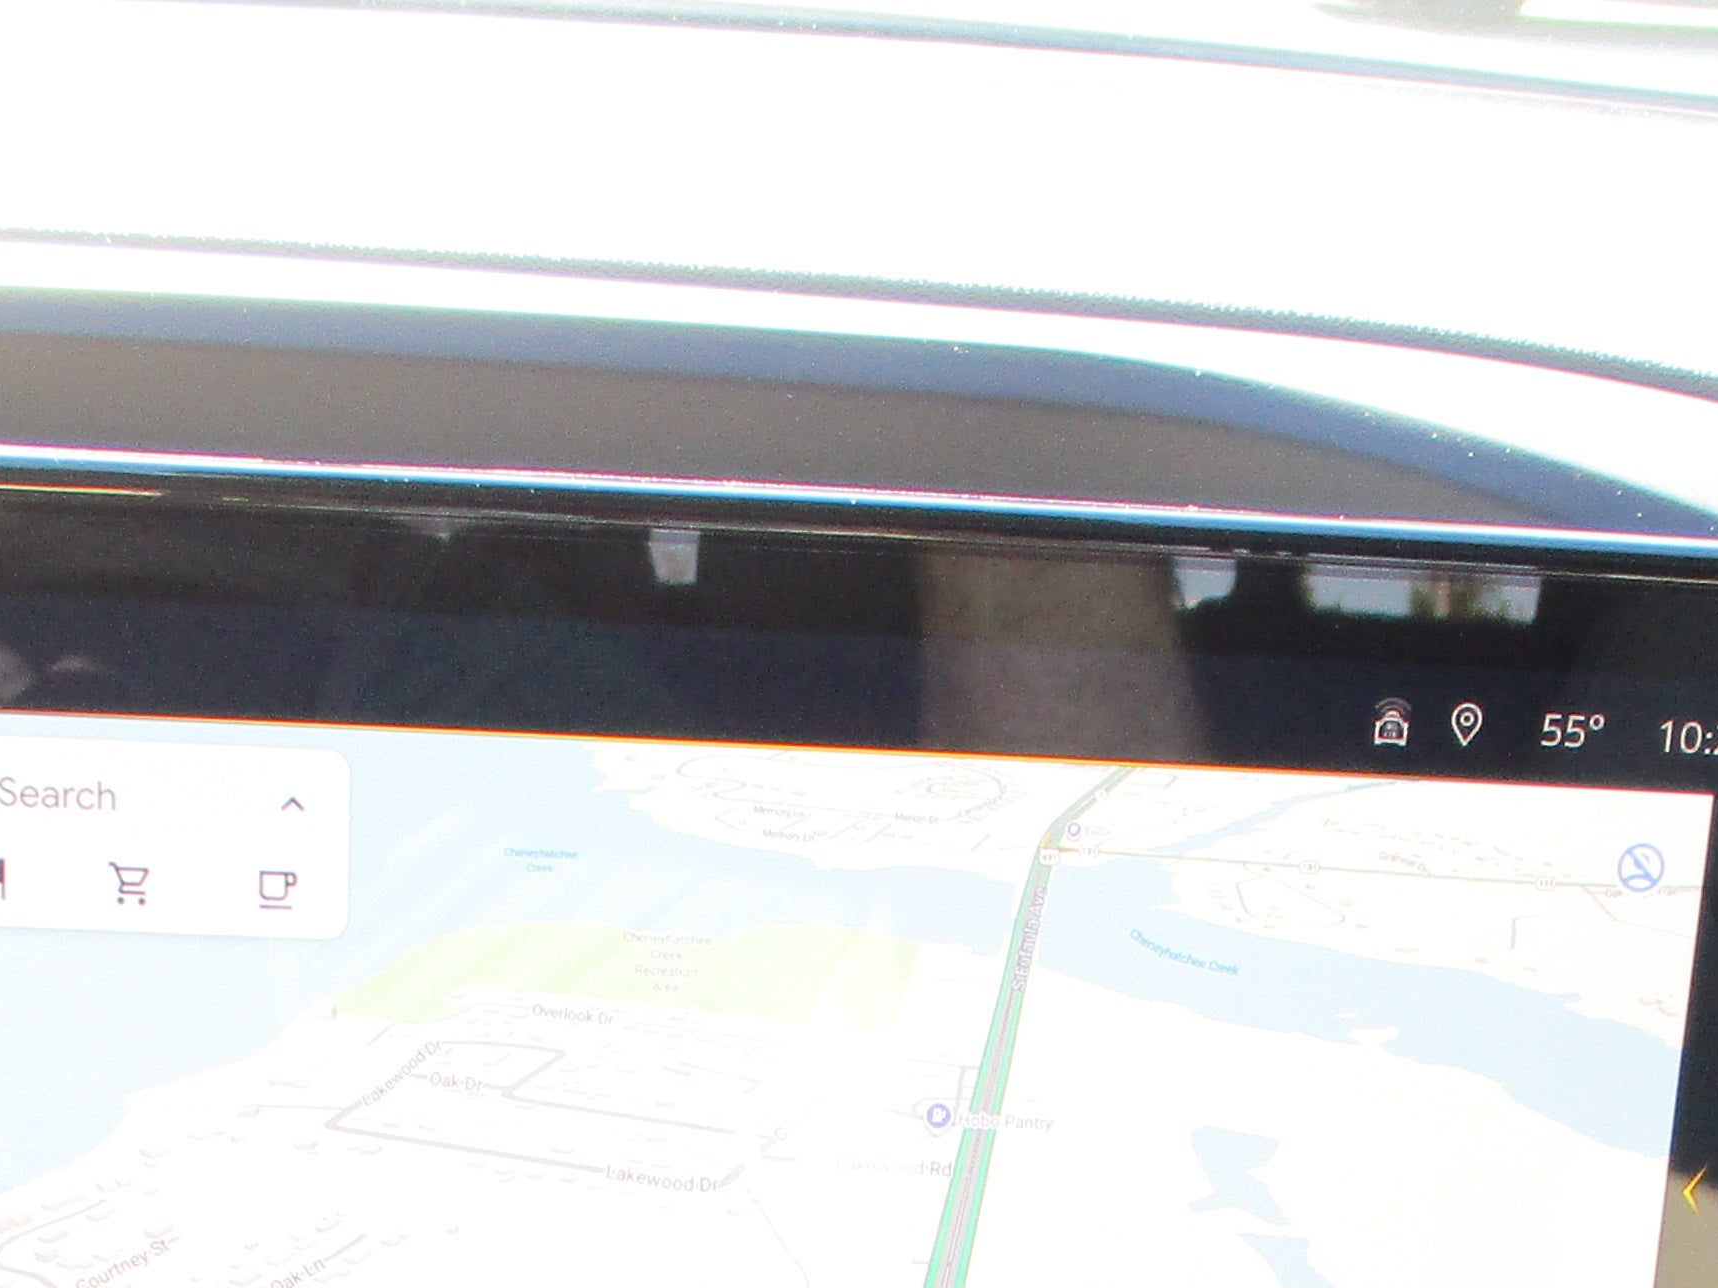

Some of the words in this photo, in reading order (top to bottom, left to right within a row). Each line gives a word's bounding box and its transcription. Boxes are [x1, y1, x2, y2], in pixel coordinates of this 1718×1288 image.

[532, 1003, 595, 1023] Overlook
[597, 1011, 614, 1025] Dr
[360, 1049, 427, 1107] Lakewood
[424, 1038, 444, 1057] Dr
[429, 1071, 460, 1089] Oak
[464, 1076, 484, 1092] Dr
[957, 1113, 1000, 1130] Hobo
[1004, 1114, 1054, 1132] Pantry
[605, 1164, 695, 1192] Lakewood
[699, 1177, 720, 1193] Dr
[928, 1160, 953, 1177] Rd
[149, 1238, 170, 1256] St
[303, 1257, 327, 1276] Ln
